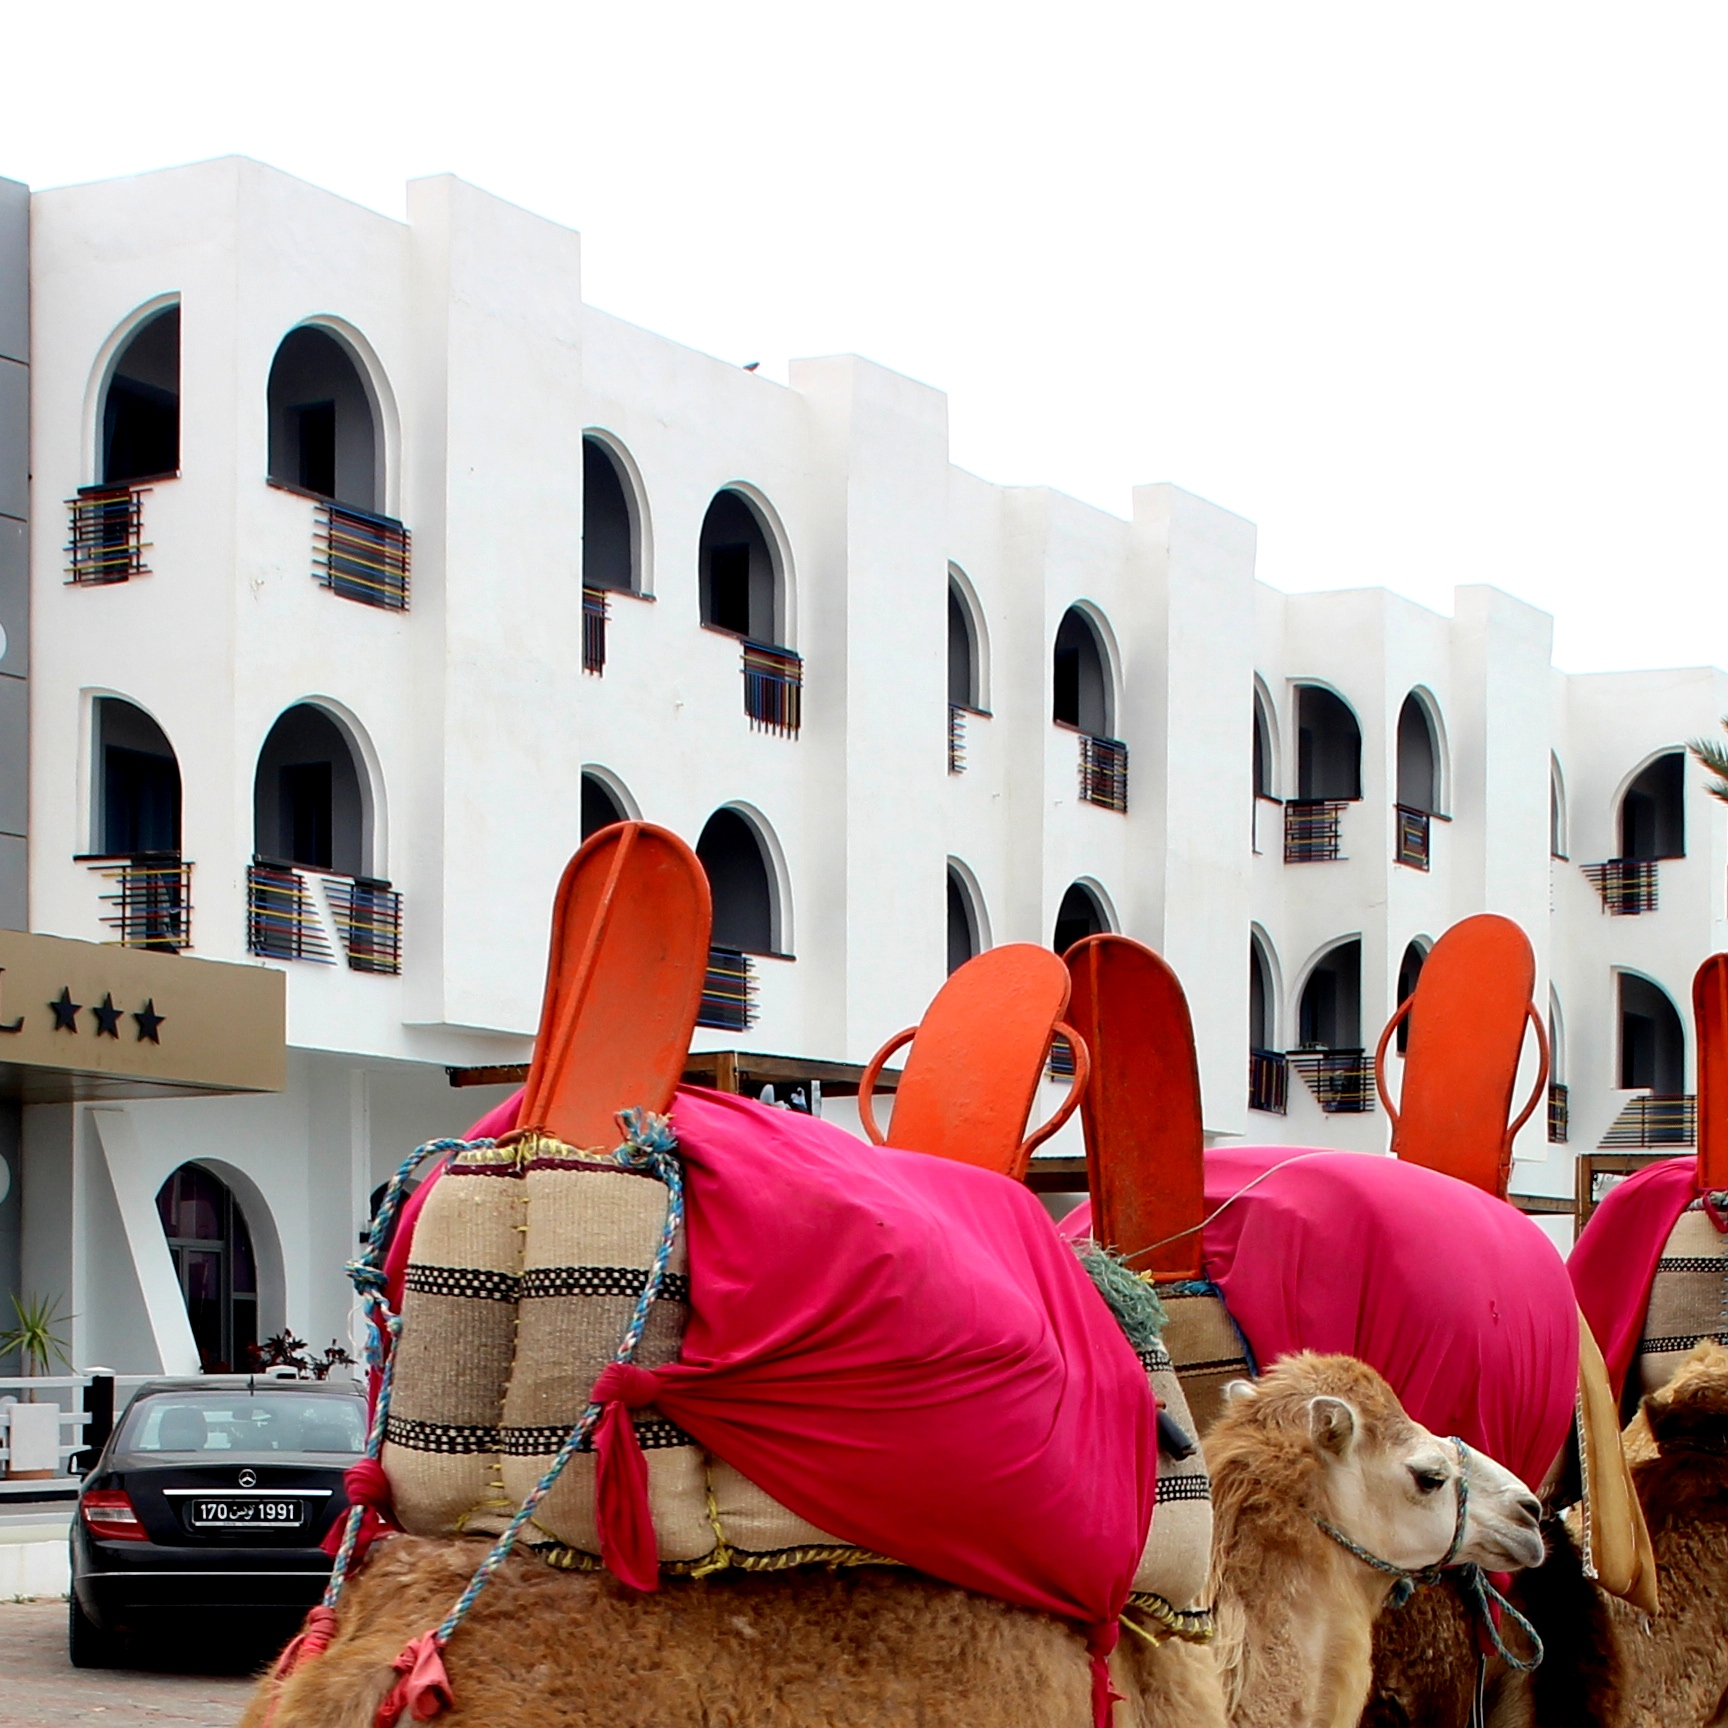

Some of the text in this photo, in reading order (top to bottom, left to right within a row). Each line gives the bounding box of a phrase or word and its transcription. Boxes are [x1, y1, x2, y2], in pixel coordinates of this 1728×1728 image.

[200, 1503, 294, 1520] 170 تونس 1991
